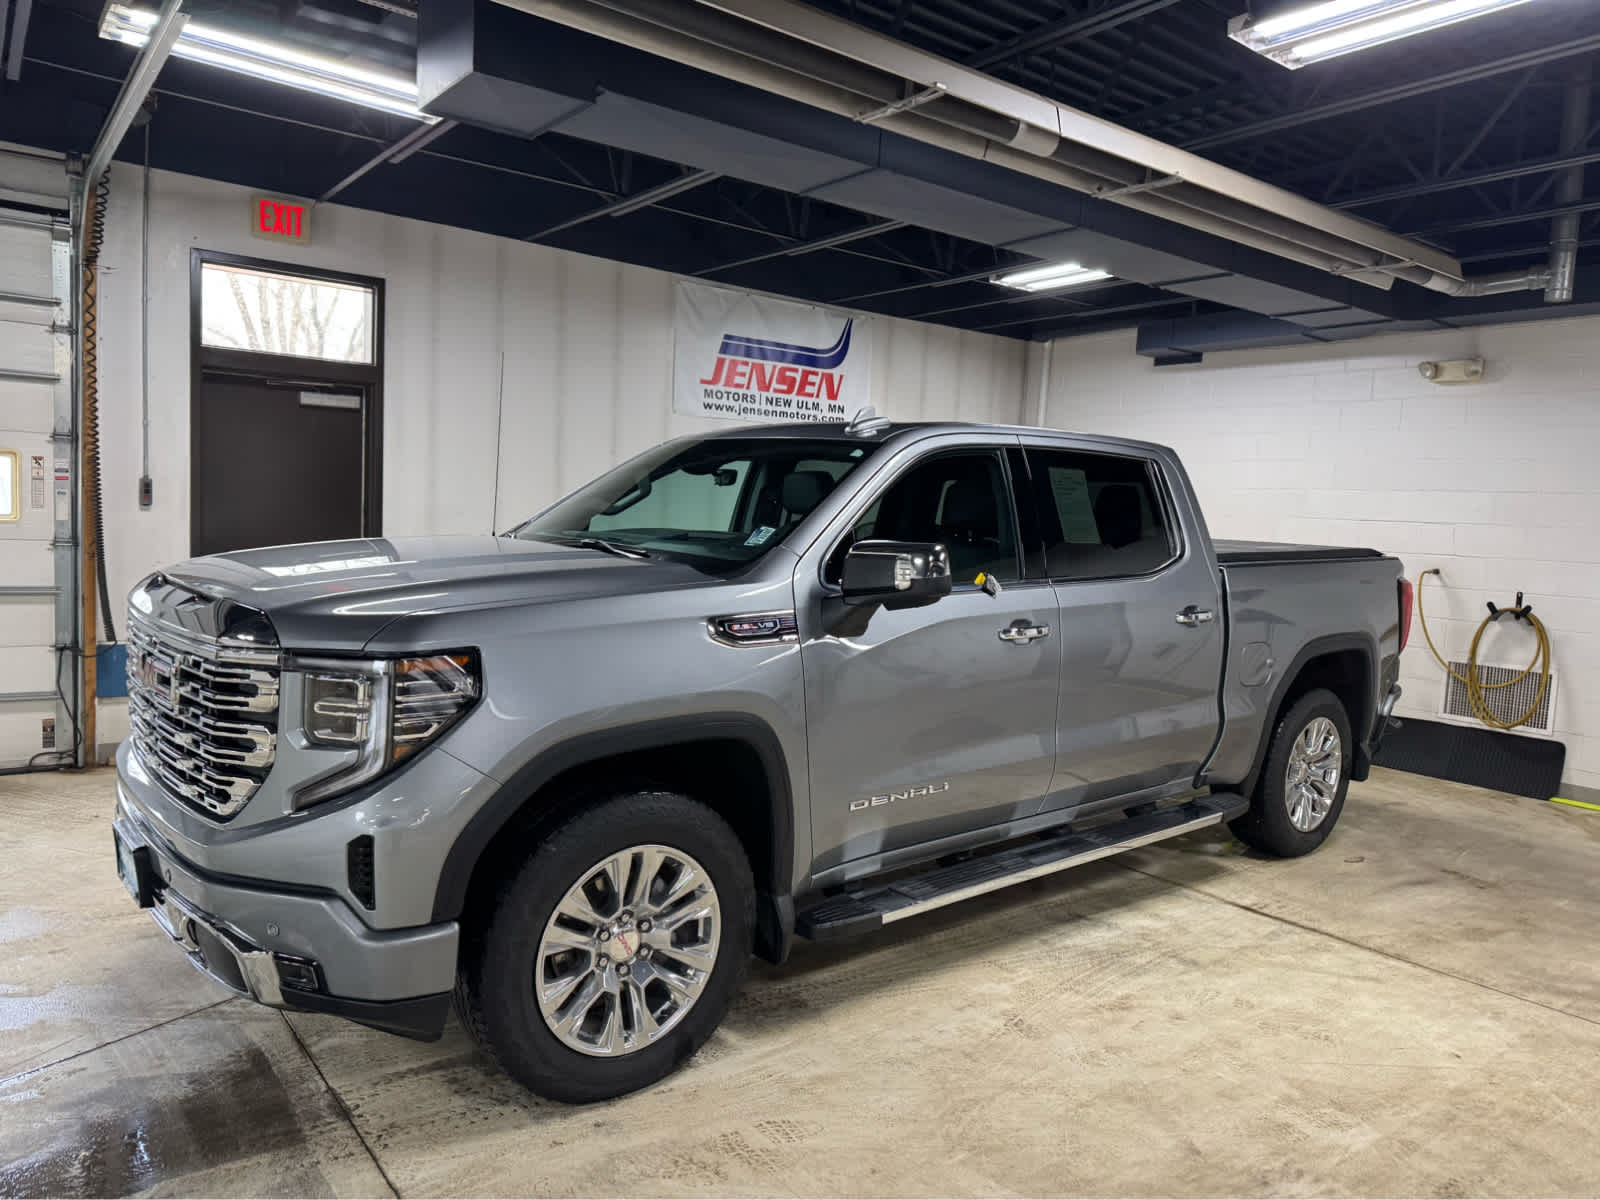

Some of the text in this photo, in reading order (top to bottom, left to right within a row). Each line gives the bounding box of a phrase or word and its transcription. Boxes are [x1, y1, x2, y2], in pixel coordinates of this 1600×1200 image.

[260, 200, 305, 238] EXIT
[700, 356, 845, 401] JENSEN
[703, 388, 845, 414] MOTORS NEW ULM, MN
[703, 401, 845, 422] www.jensenmotors.com
[849, 781, 950, 811] DENALI
